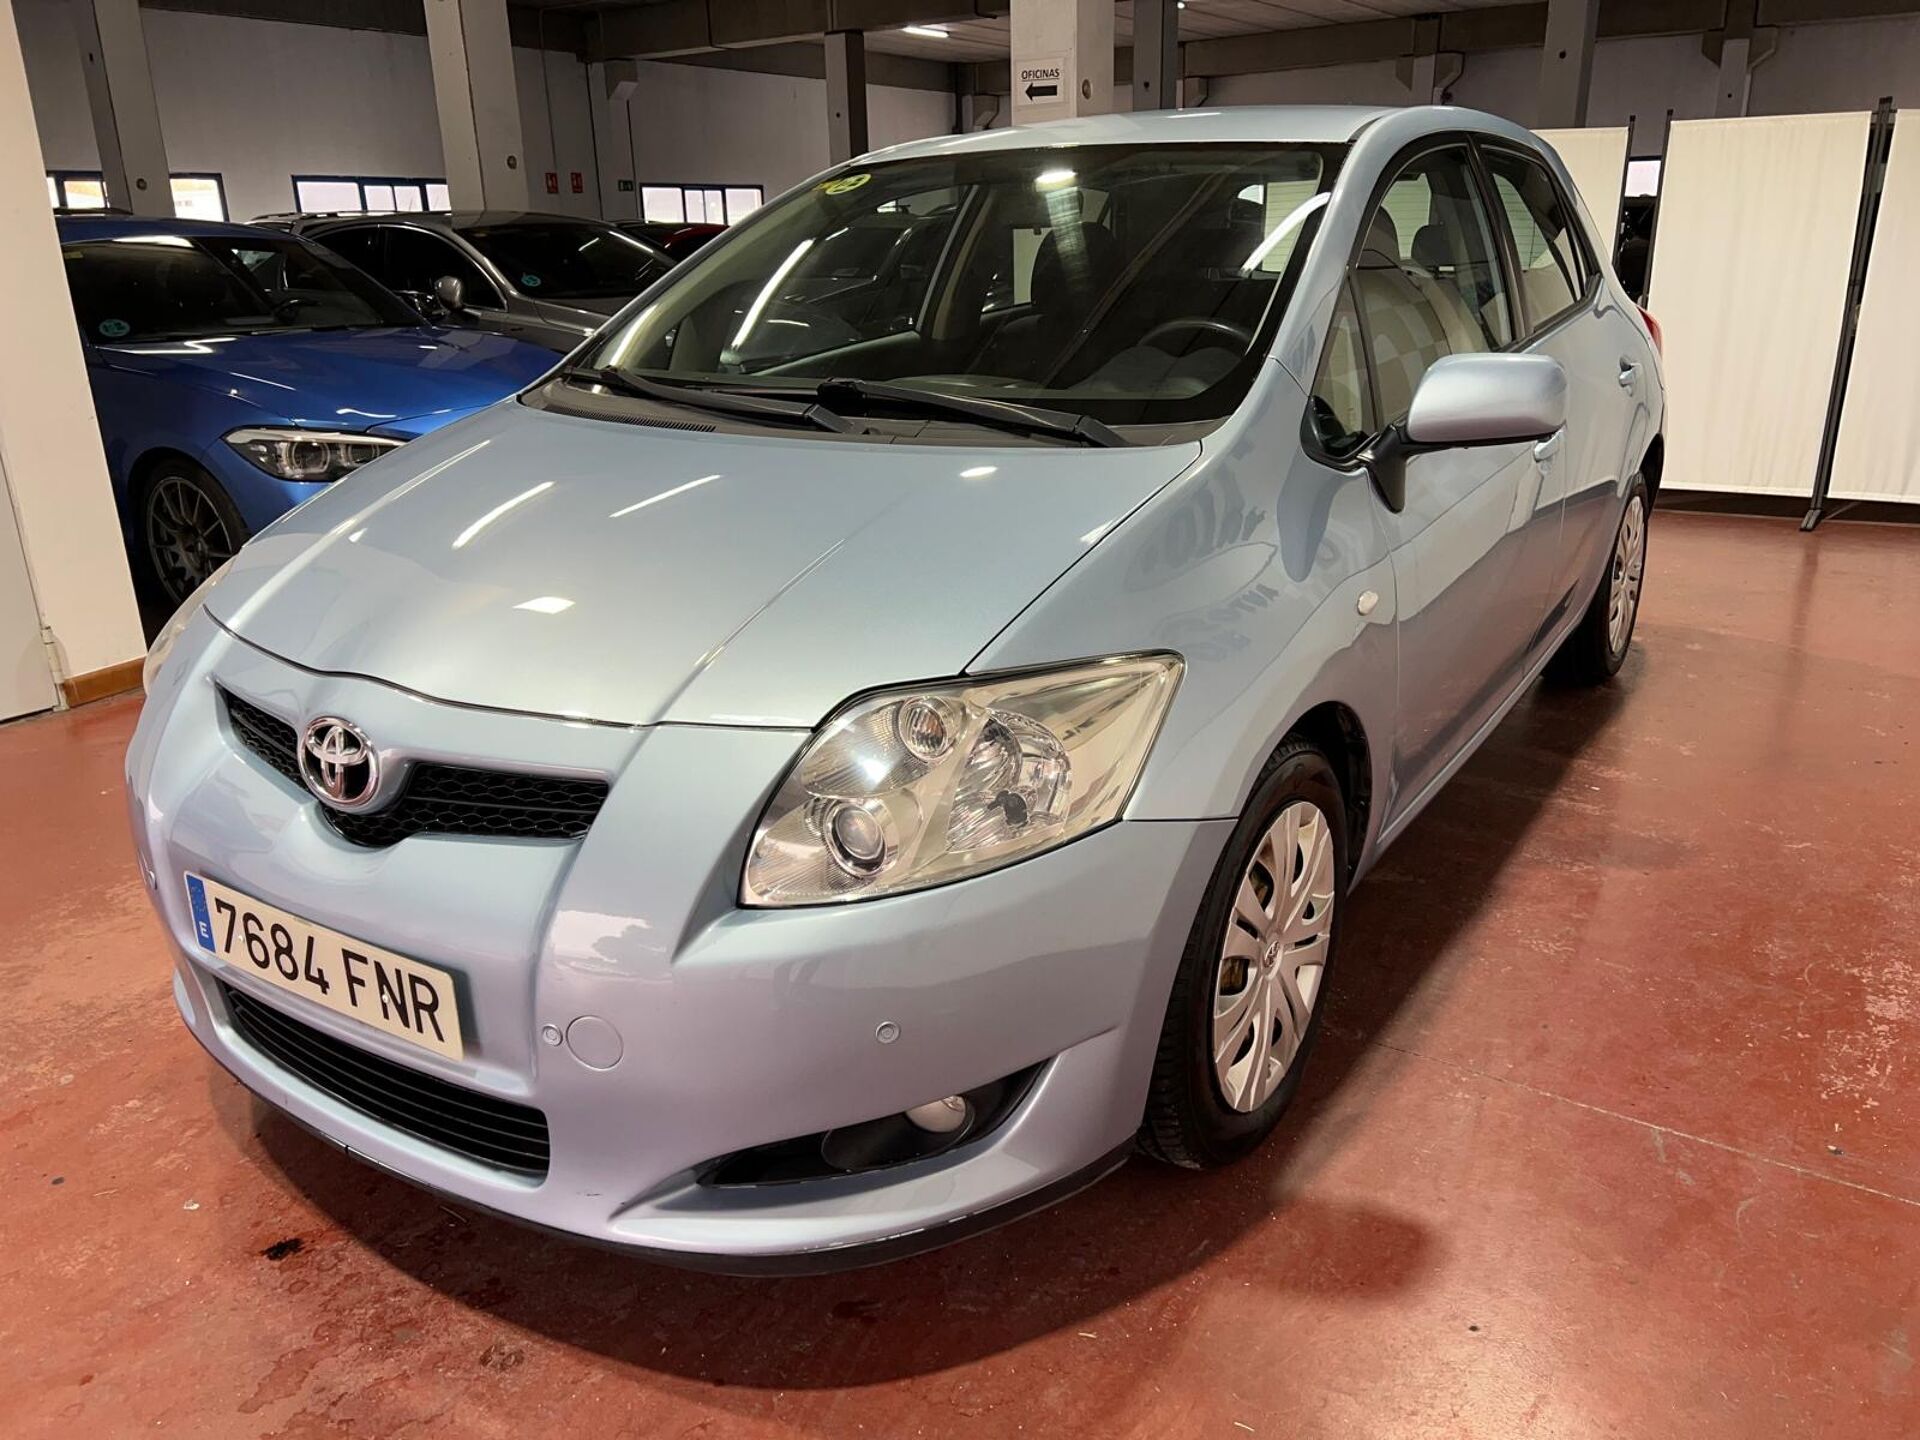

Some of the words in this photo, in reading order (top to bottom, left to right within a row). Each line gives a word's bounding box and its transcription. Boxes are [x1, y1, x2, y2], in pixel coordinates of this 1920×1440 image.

[1021, 68, 1060, 80] OFICINAS
[199, 920, 209, 938] E
[215, 897, 330, 995] 7684
[341, 948, 445, 1043] FNR
